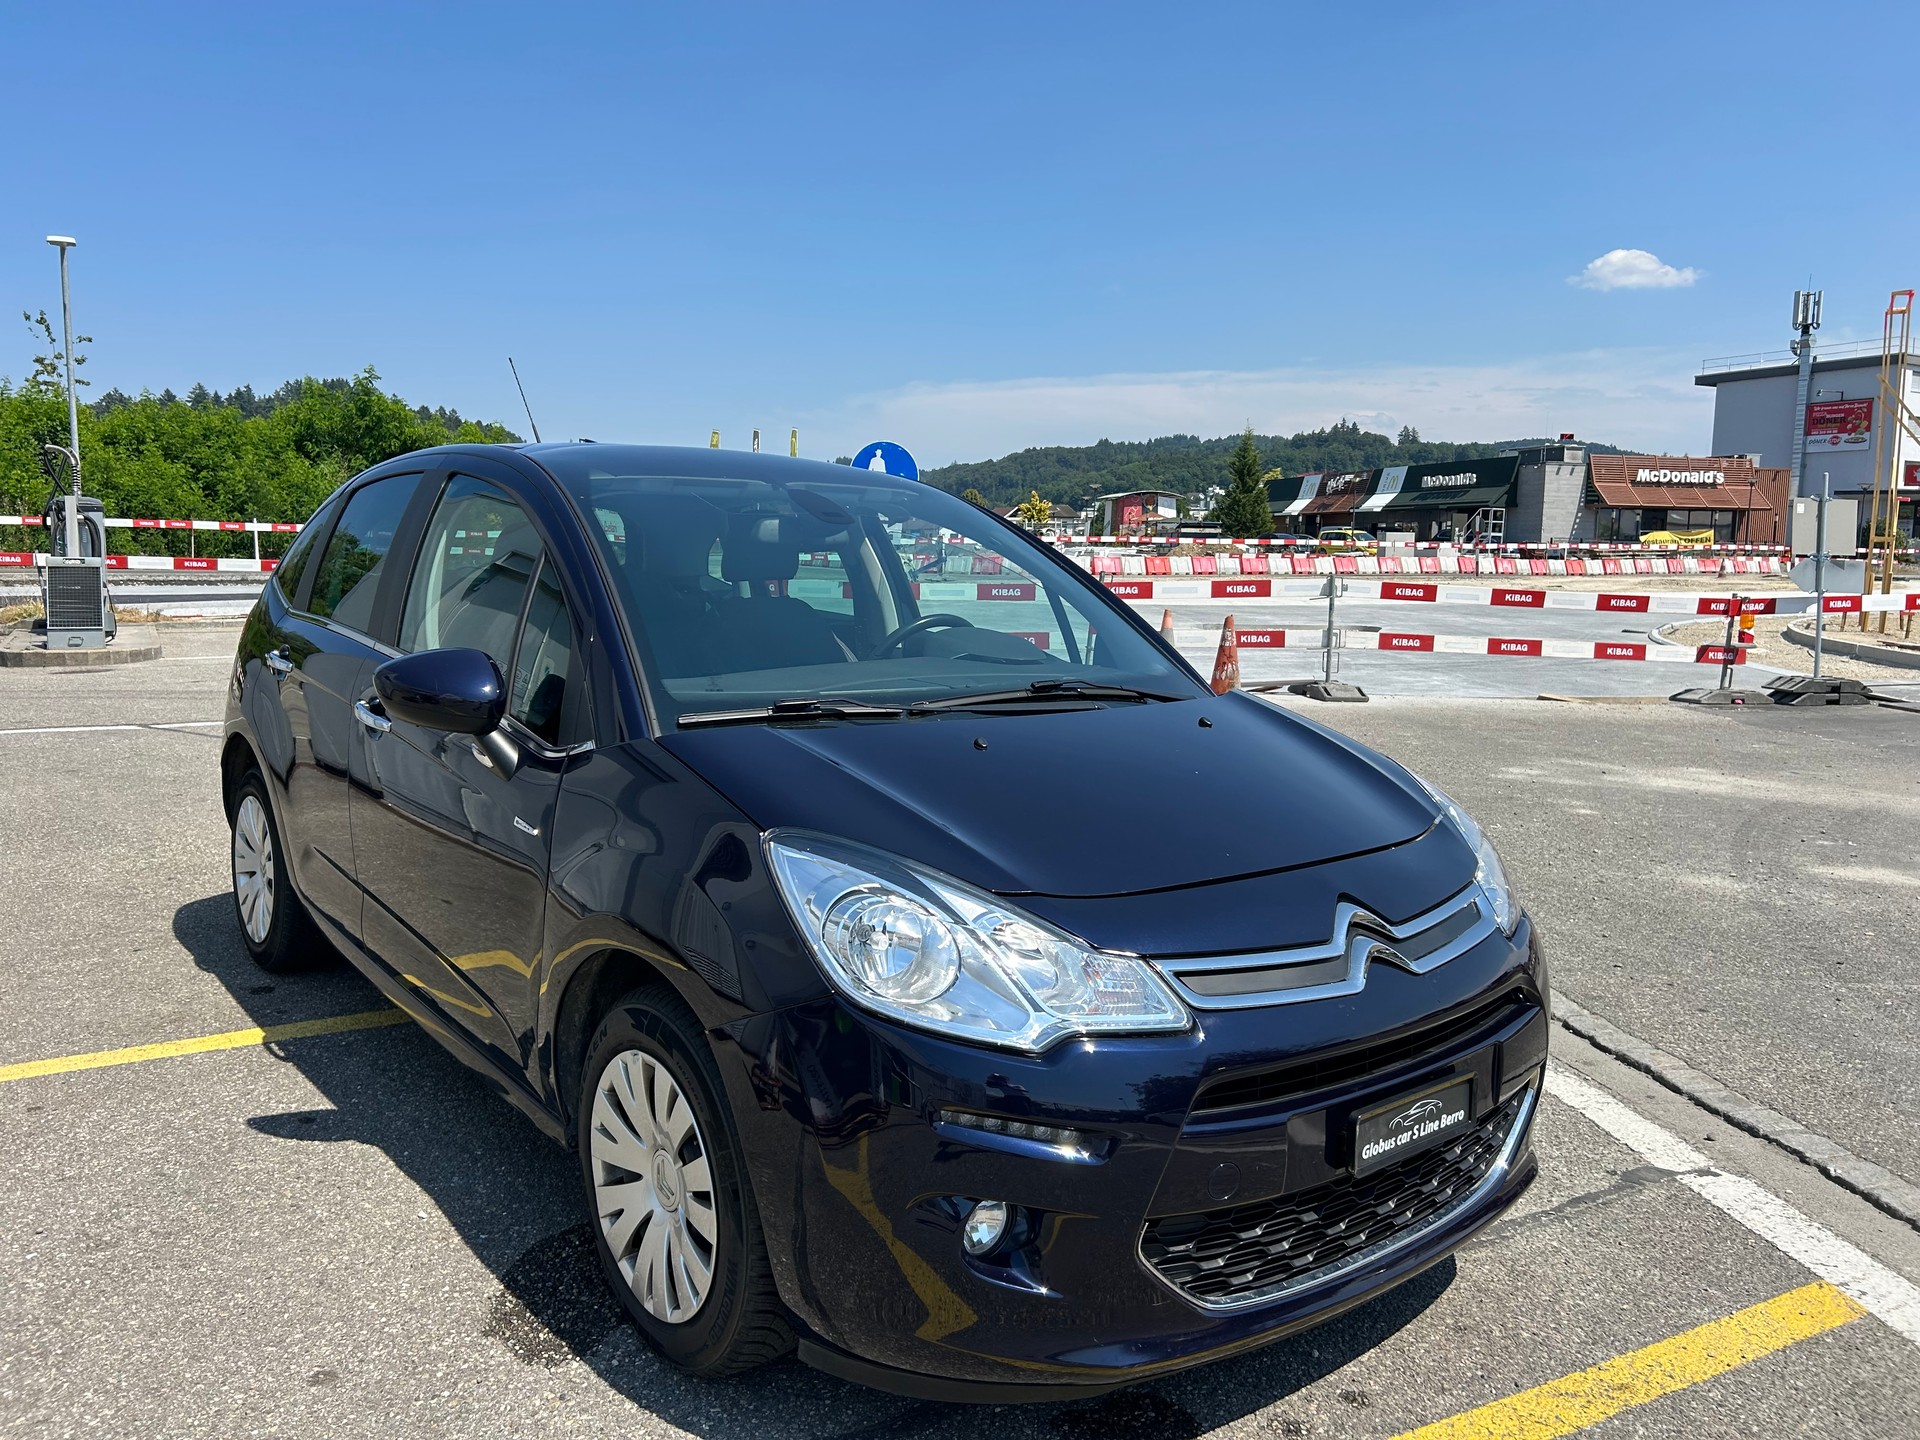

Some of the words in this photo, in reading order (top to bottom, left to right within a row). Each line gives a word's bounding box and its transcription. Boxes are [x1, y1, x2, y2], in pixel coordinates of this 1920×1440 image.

[1421, 472, 1477, 488] McDonald's
[1636, 469, 1725, 484] McDonald's
[1684, 536, 1711, 544] OFFEN
[991, 588, 1021, 596] KIBAG
[1226, 585, 1257, 593] KIBAG
[1395, 587, 1424, 597] KIBAG
[1505, 593, 1533, 603] KIBAG
[1610, 598, 1637, 608] KIBAG
[1829, 600, 1852, 608] KIBAG
[1240, 635, 1271, 643] KIBAG
[1392, 638, 1420, 647] KIBAG
[1501, 642, 1528, 652] KIBAG
[1607, 647, 1633, 656] KIBAG
[1708, 651, 1734, 660] KIBAG
[1362, 1136, 1396, 1160] Globus
[1396, 1130, 1413, 1145] car
[1412, 1124, 1420, 1140] S
[1419, 1119, 1440, 1137] Line
[1440, 1109, 1465, 1129] Berro
